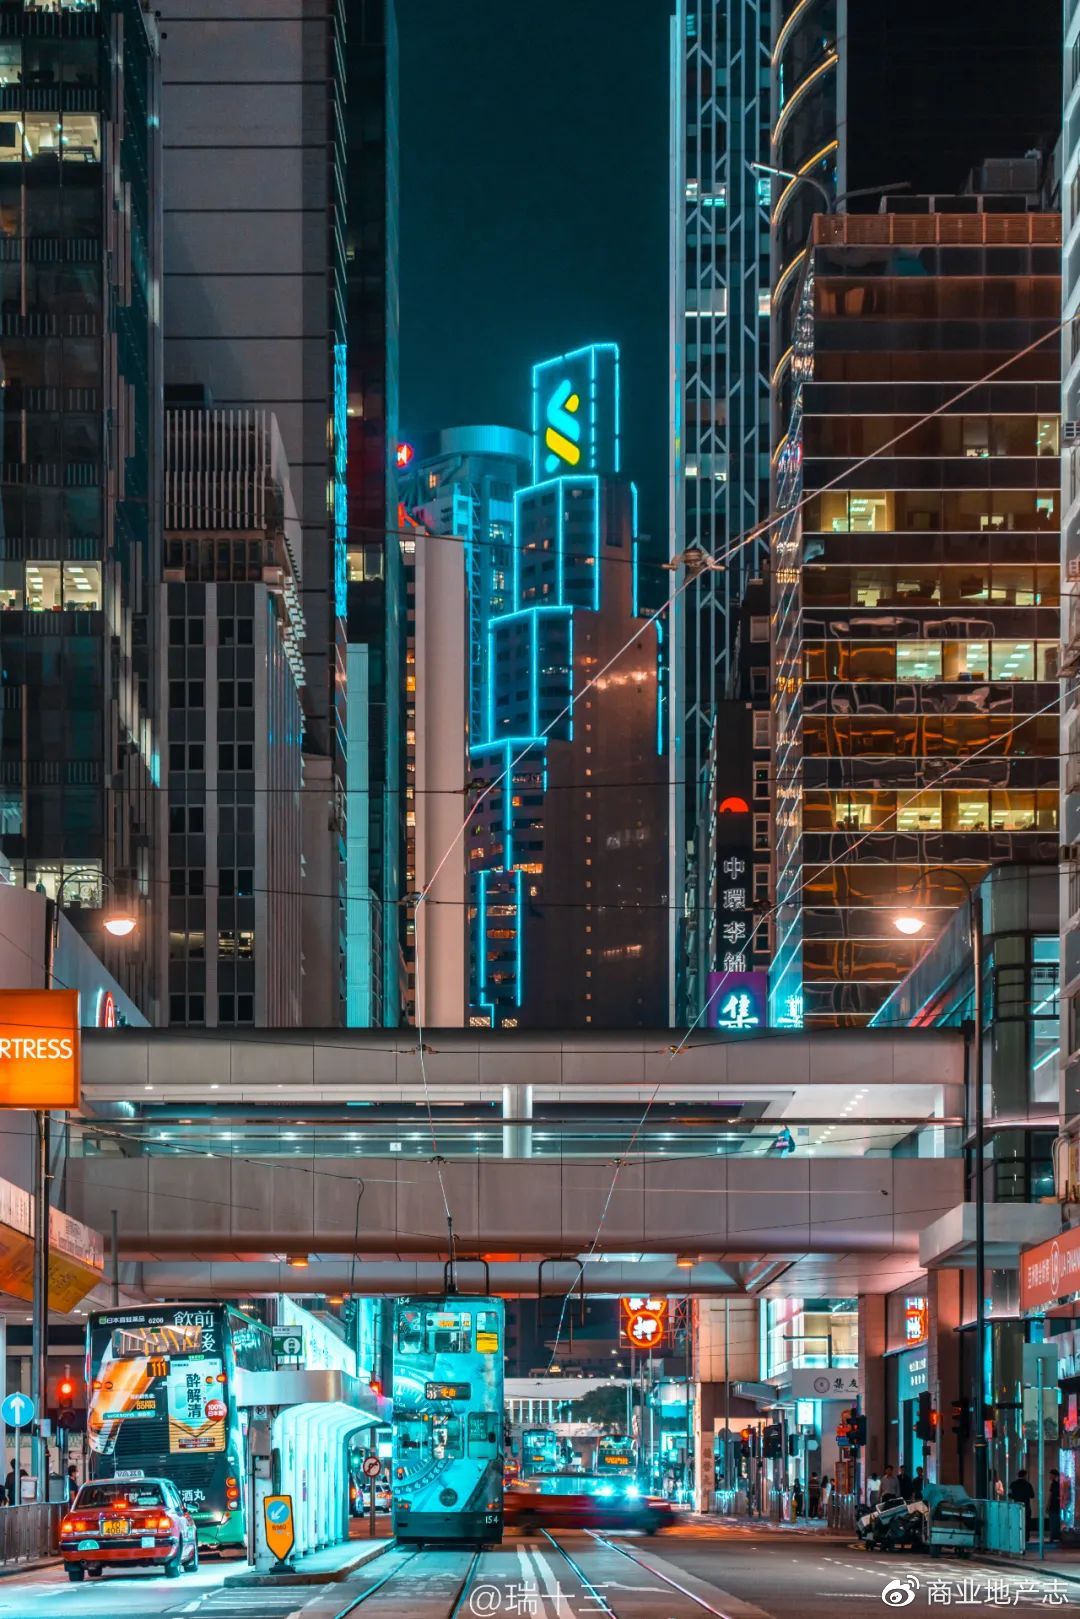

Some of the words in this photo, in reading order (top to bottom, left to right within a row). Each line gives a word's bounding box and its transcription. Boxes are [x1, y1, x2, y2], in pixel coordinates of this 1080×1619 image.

[0, 1038, 73, 1059] RTRESS
[397, 1297, 410, 1305] 154
[179, 1489, 206, 1502] 酒丸
[485, 1515, 498, 1524] 154
